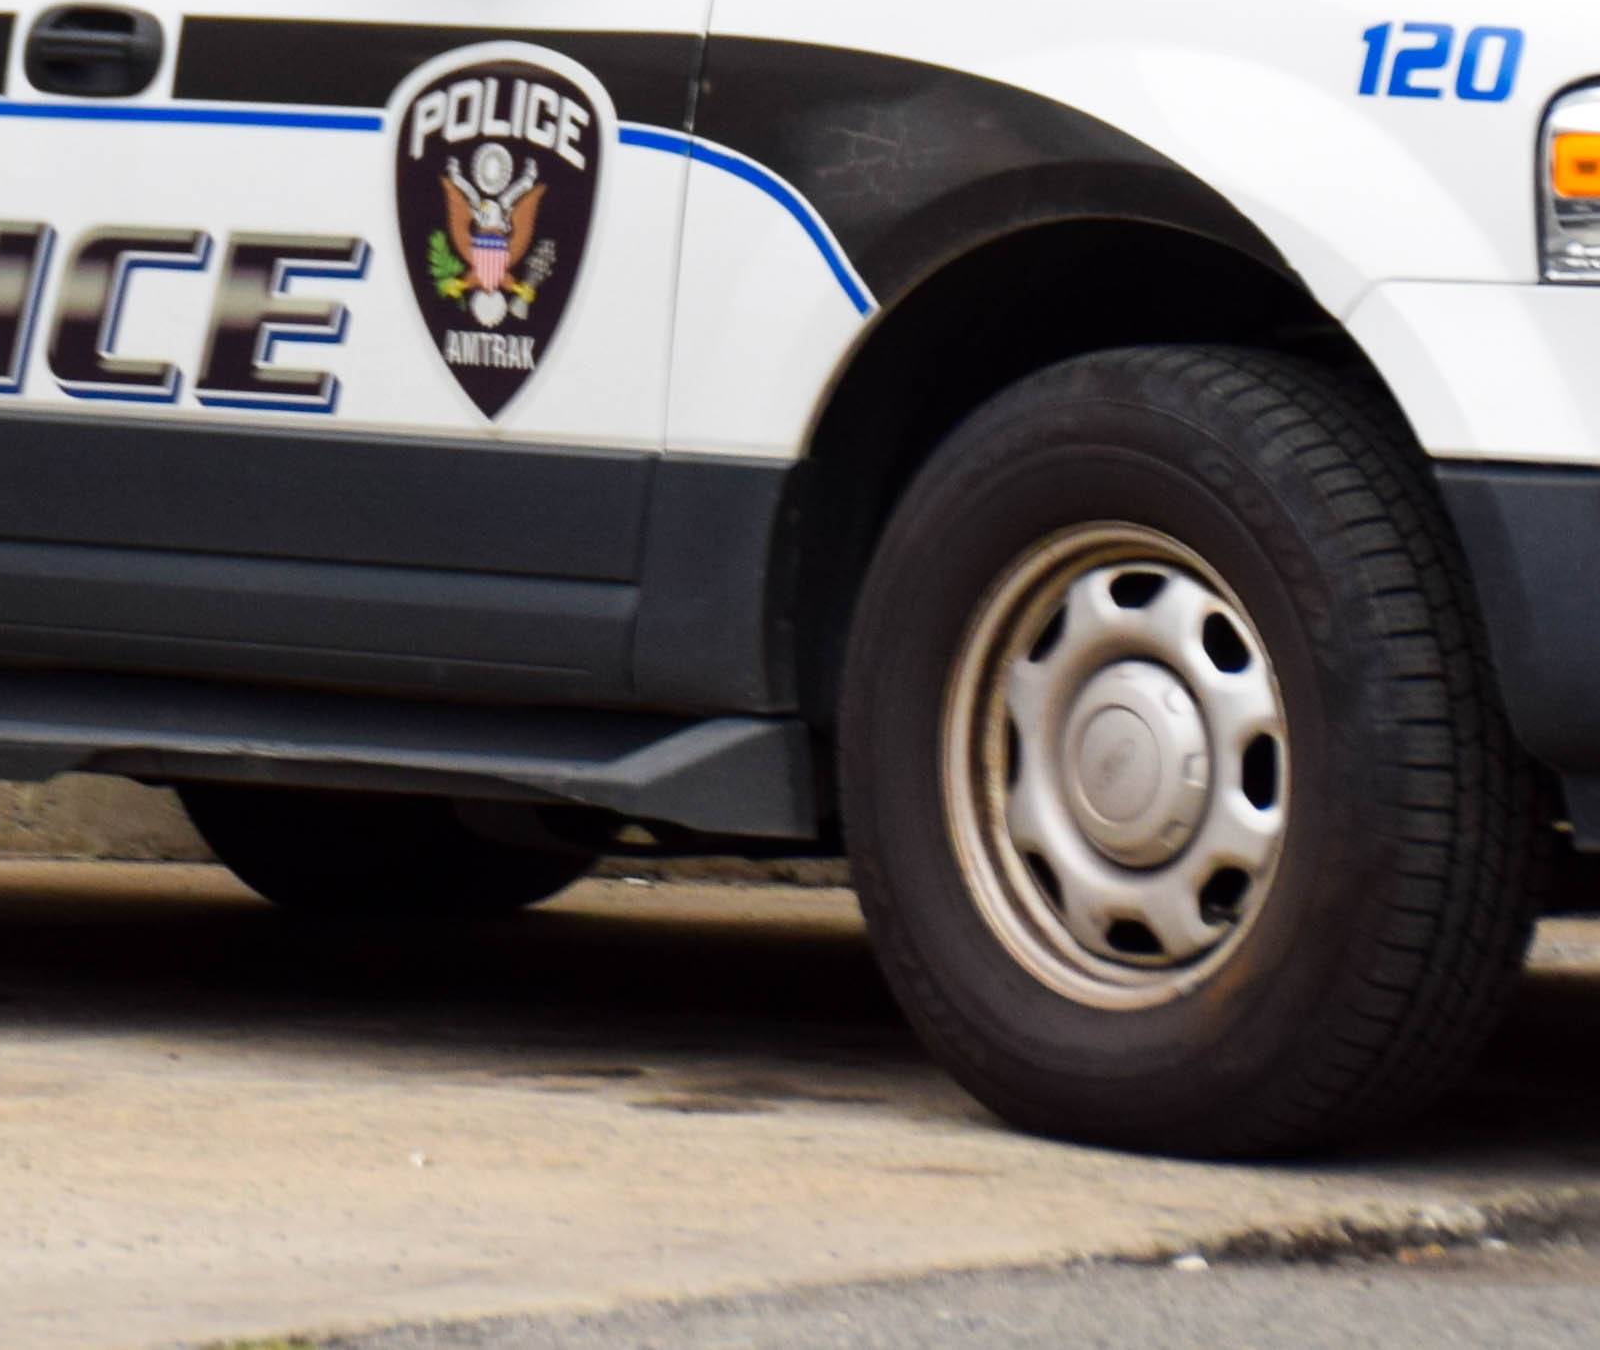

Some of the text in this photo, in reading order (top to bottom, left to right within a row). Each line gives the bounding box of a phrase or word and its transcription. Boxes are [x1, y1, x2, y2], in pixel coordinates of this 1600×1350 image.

[1357, 21, 1526, 103] 120
[409, 77, 590, 170] POLICE
[445, 328, 536, 370] AMTRAK
